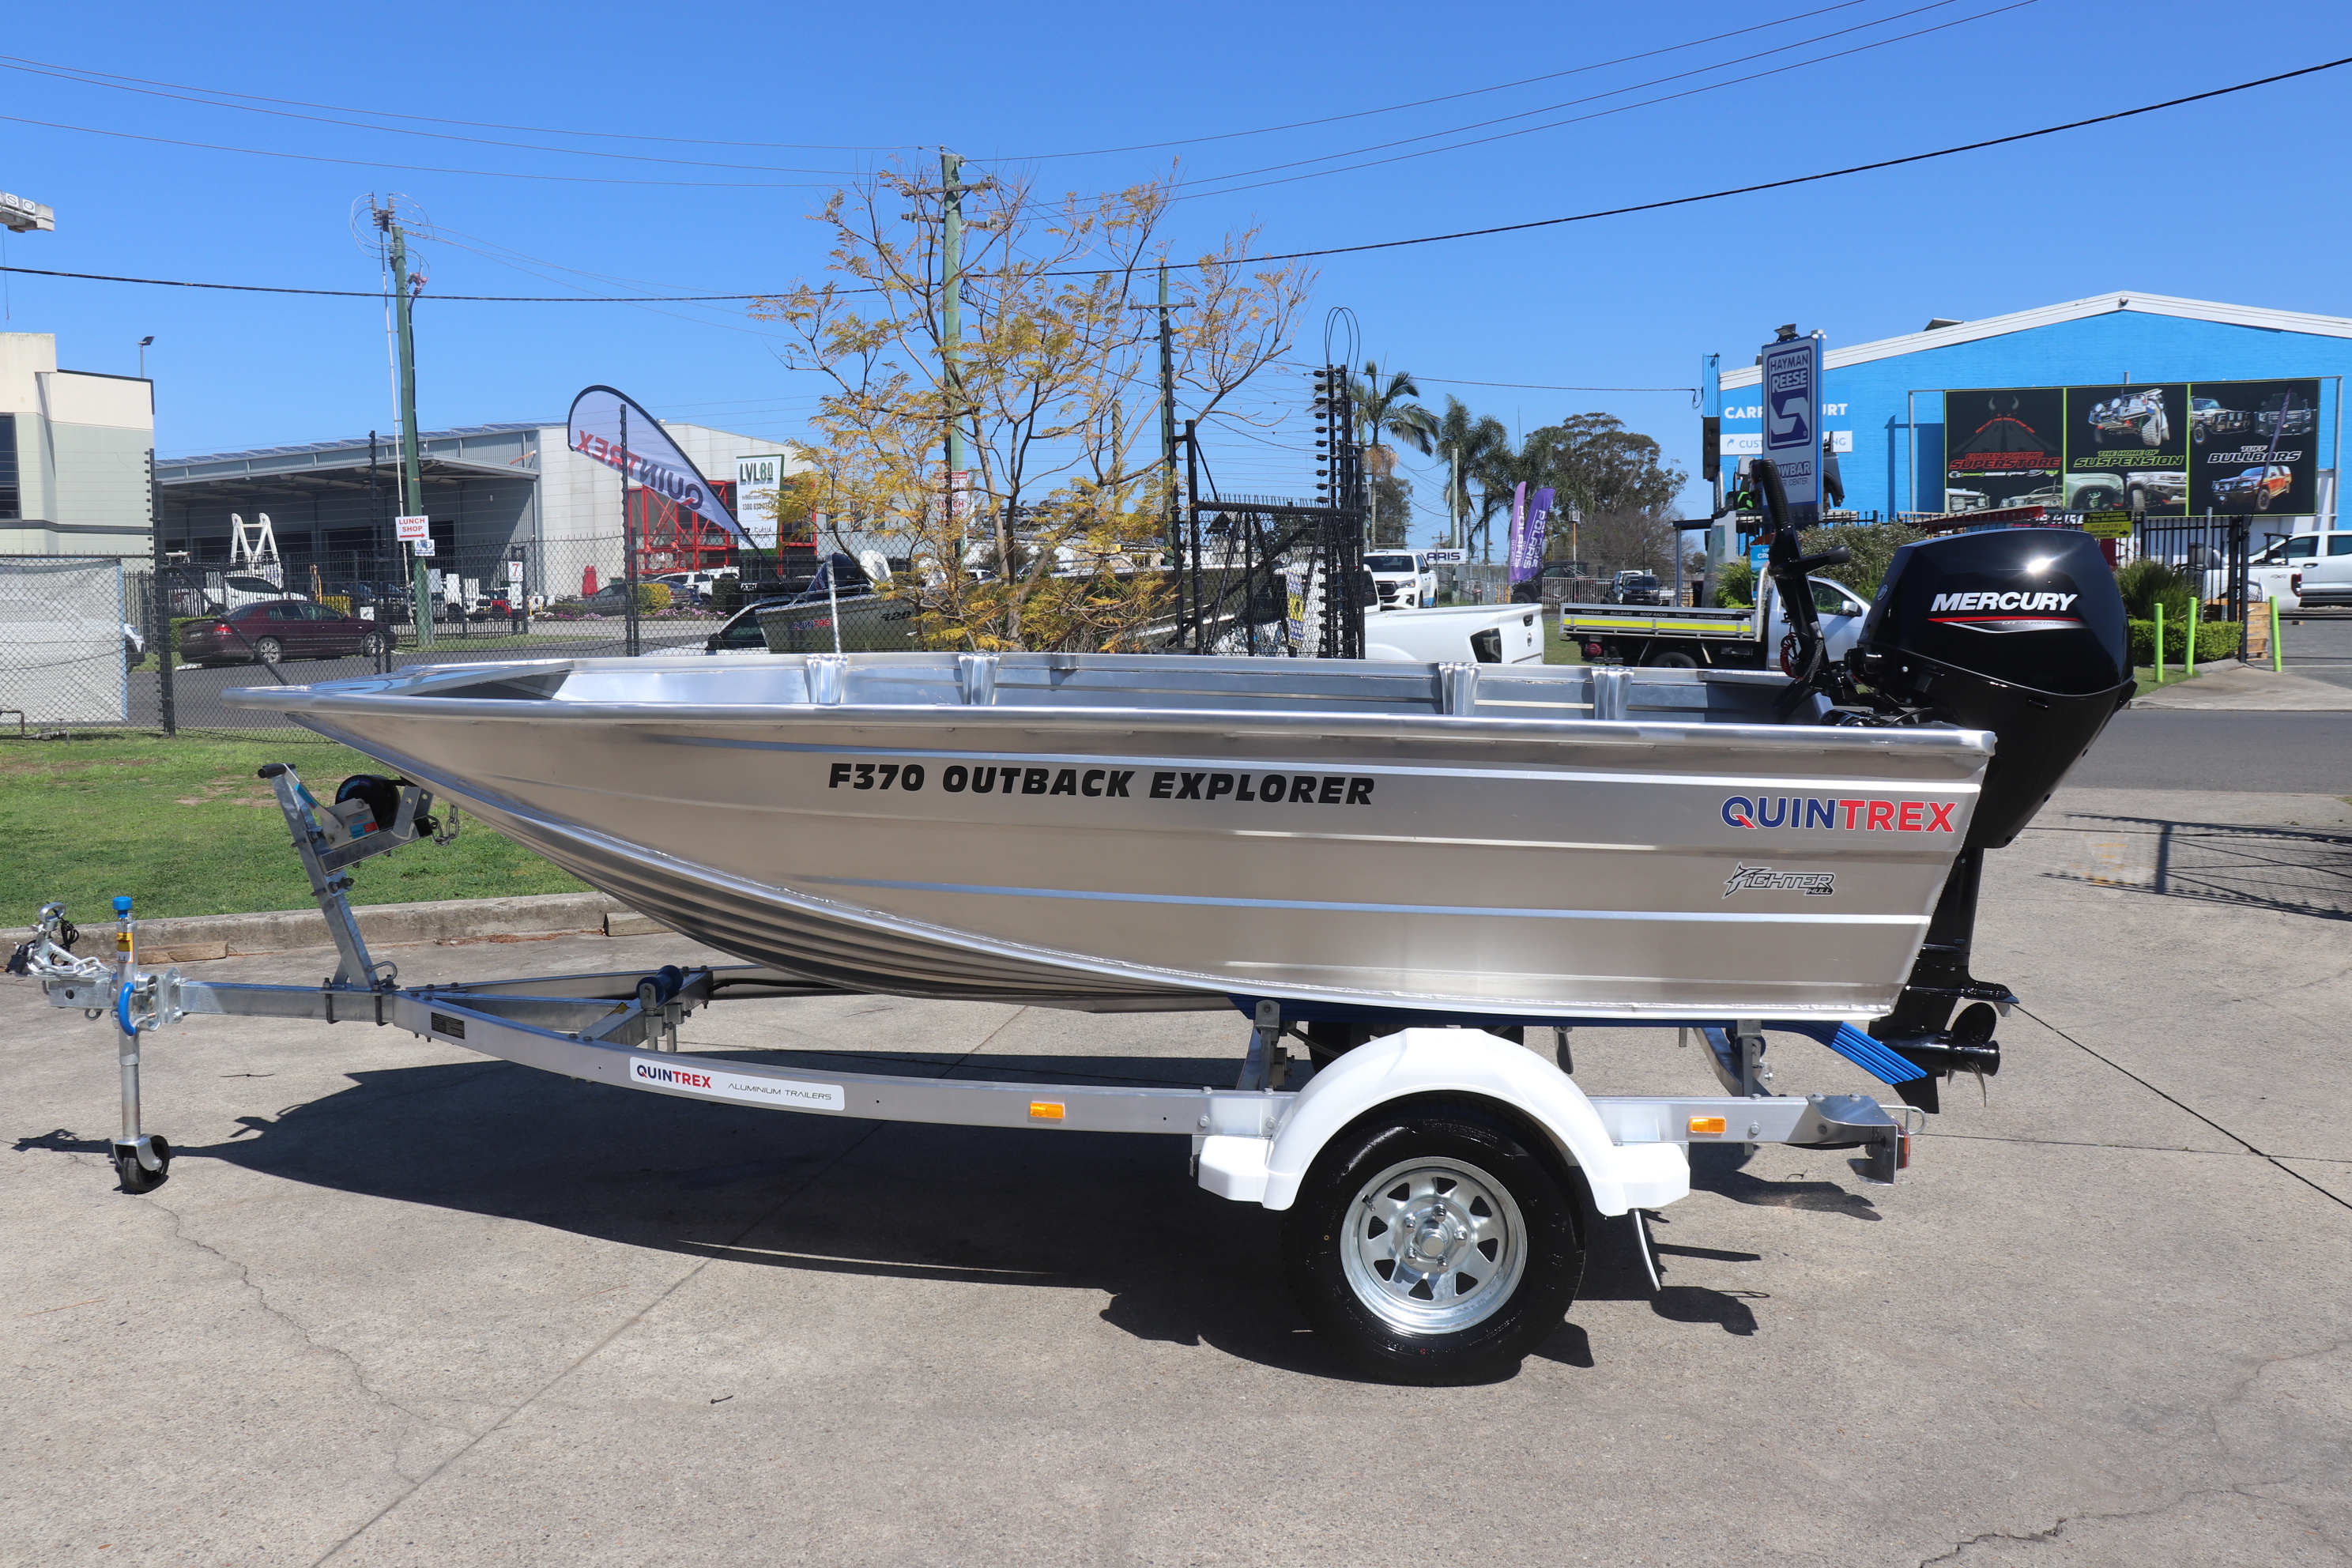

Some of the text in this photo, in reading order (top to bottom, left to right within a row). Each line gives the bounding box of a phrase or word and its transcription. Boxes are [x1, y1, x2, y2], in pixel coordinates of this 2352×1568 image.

[1770, 353, 1808, 371] HAYMAN
[1772, 370, 1807, 394] REESE
[1724, 405, 1763, 420] CAR
[1948, 457, 2062, 469] SUPERSTORE
[2073, 455, 2184, 468] SUSPENSION
[2207, 450, 2302, 463] BULLBARS
[1777, 461, 1811, 478] WBAR
[1524, 509, 1546, 569] POLARIS
[1427, 552, 1461, 561] ARIS
[512, 563, 519, 577] 7
[1930, 591, 2079, 612] MERCURY
[880, 611, 910, 621] 420
[828, 763, 1375, 805] F370 OUTBACK EXPLORER
[1721, 795, 1958, 833] QUINTREX
[636, 1064, 832, 1101] QUINTREX ALUMINIUM TRAILERS
